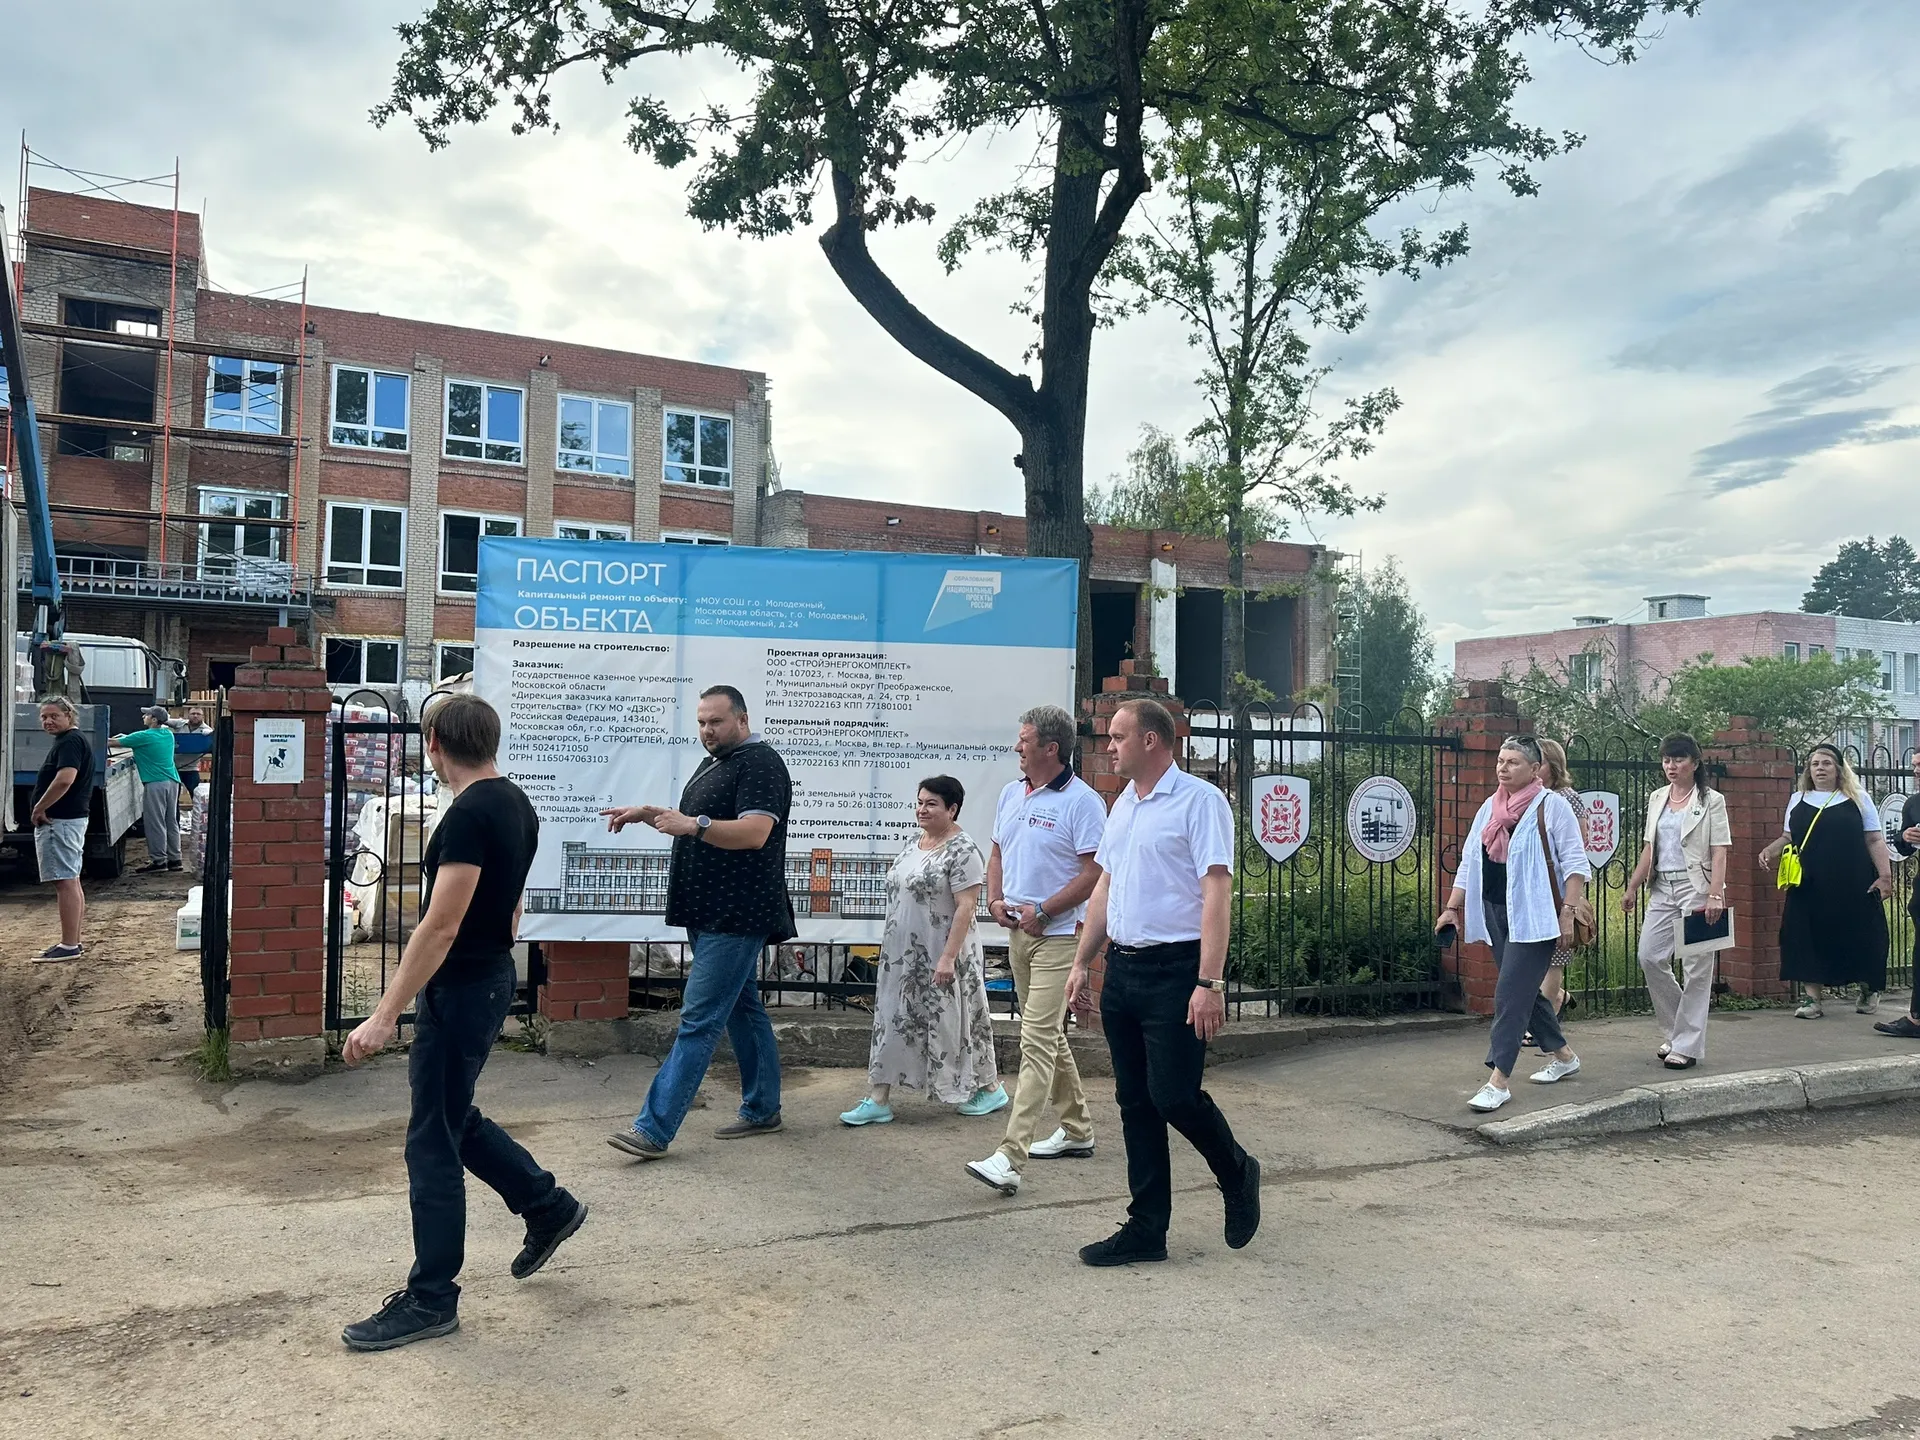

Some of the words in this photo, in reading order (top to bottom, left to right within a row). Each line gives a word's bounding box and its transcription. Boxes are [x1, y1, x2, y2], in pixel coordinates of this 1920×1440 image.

[517, 558, 667, 586] ПАСПОРТ
[947, 586, 993, 594] НАЦИОНАЛЬНЫЕ
[518, 590, 586, 600] Капитальный
[590, 593, 625, 602] ремонт
[644, 594, 688, 604] объекту:
[696, 597, 720, 605] «МОУ
[723, 598, 744, 606] СОШ
[766, 600, 826, 610] Молодежный,
[514, 605, 653, 633] ОБЪЕКТА
[695, 607, 747, 616] Московская
[750, 609, 787, 618] область,
[809, 611, 868, 622] Молодежный,
[716, 618, 776, 628] Молодежный,
[513, 640, 576, 650] Разрешение
[594, 644, 670, 652] строительство:
[767, 649, 819, 658] Проектная
[822, 651, 887, 660] организация:
[512, 660, 563, 669] Заказчик:
[790, 659, 911, 670] «СТРОЙЭНЕРГОКОМПЛЕКТ»
[512, 670, 590, 681] Государственное
[594, 674, 635, 682] казенное
[638, 675, 693, 684] учреждение
[766, 670, 785, 678] ю/а:
[790, 670, 824, 678] 107023,
[837, 671, 872, 680] Москва,
[875, 673, 905, 681] вн.тер.
[511, 681, 566, 690] Московской
[569, 682, 605, 691] области
[776, 679, 848, 689] Муниципальный
[850, 683, 875, 691] округ
[877, 683, 953, 692] Преображенское,
[511, 691, 562, 701] «Дирекция
[565, 694, 612, 702] заказчика
[615, 695, 677, 703] капитального
[782, 690, 865, 700] Электрозаводская,
[879, 693, 892, 701] 24,
[511, 703, 582, 711] строительства»
[585, 704, 605, 713] (ГКУ
[627, 705, 666, 714] «ДЗКС»)
[788, 700, 841, 709] 1327022163
[866, 702, 912, 710] 771801001
[511, 712, 562, 721] Российская
[566, 714, 619, 723] Федерация,
[623, 715, 658, 724] 143401,
[765, 717, 830, 726] Генеральный
[834, 720, 889, 728] подрядчик:
[510, 722, 564, 731] Московская
[567, 724, 587, 732] обл,
[609, 726, 668, 735] Красногорск,
[788, 728, 909, 738] «СТРОЙЭНЕРГОКОМПЛЕКТ»
[520, 733, 580, 743] Красногорск,
[602, 735, 665, 745] СТРОИТЕЛЕЙ,
[668, 737, 688, 745] ДОМ
[787, 738, 821, 747] 107023,
[835, 740, 869, 749] Москва,
[916, 742, 986, 751] Муниципальный
[532, 744, 589, 752] 5024171050
[536, 754, 609, 763] 1165047063103
[776, 748, 840, 757] ображенское,
[860, 751, 941, 760] Электрозаводская,
[786, 759, 839, 767] 1327022163
[863, 761, 910, 769] 771801001
[507, 772, 556, 781] Строение
[563, 794, 596, 802] этажей
[807, 790, 855, 798] земельный
[540, 805, 580, 813] площадь
[803, 800, 822, 808] 0,79
[550, 815, 597, 824] застройки
[800, 819, 872, 827] строительства:
[818, 832, 890, 841] строительства:
